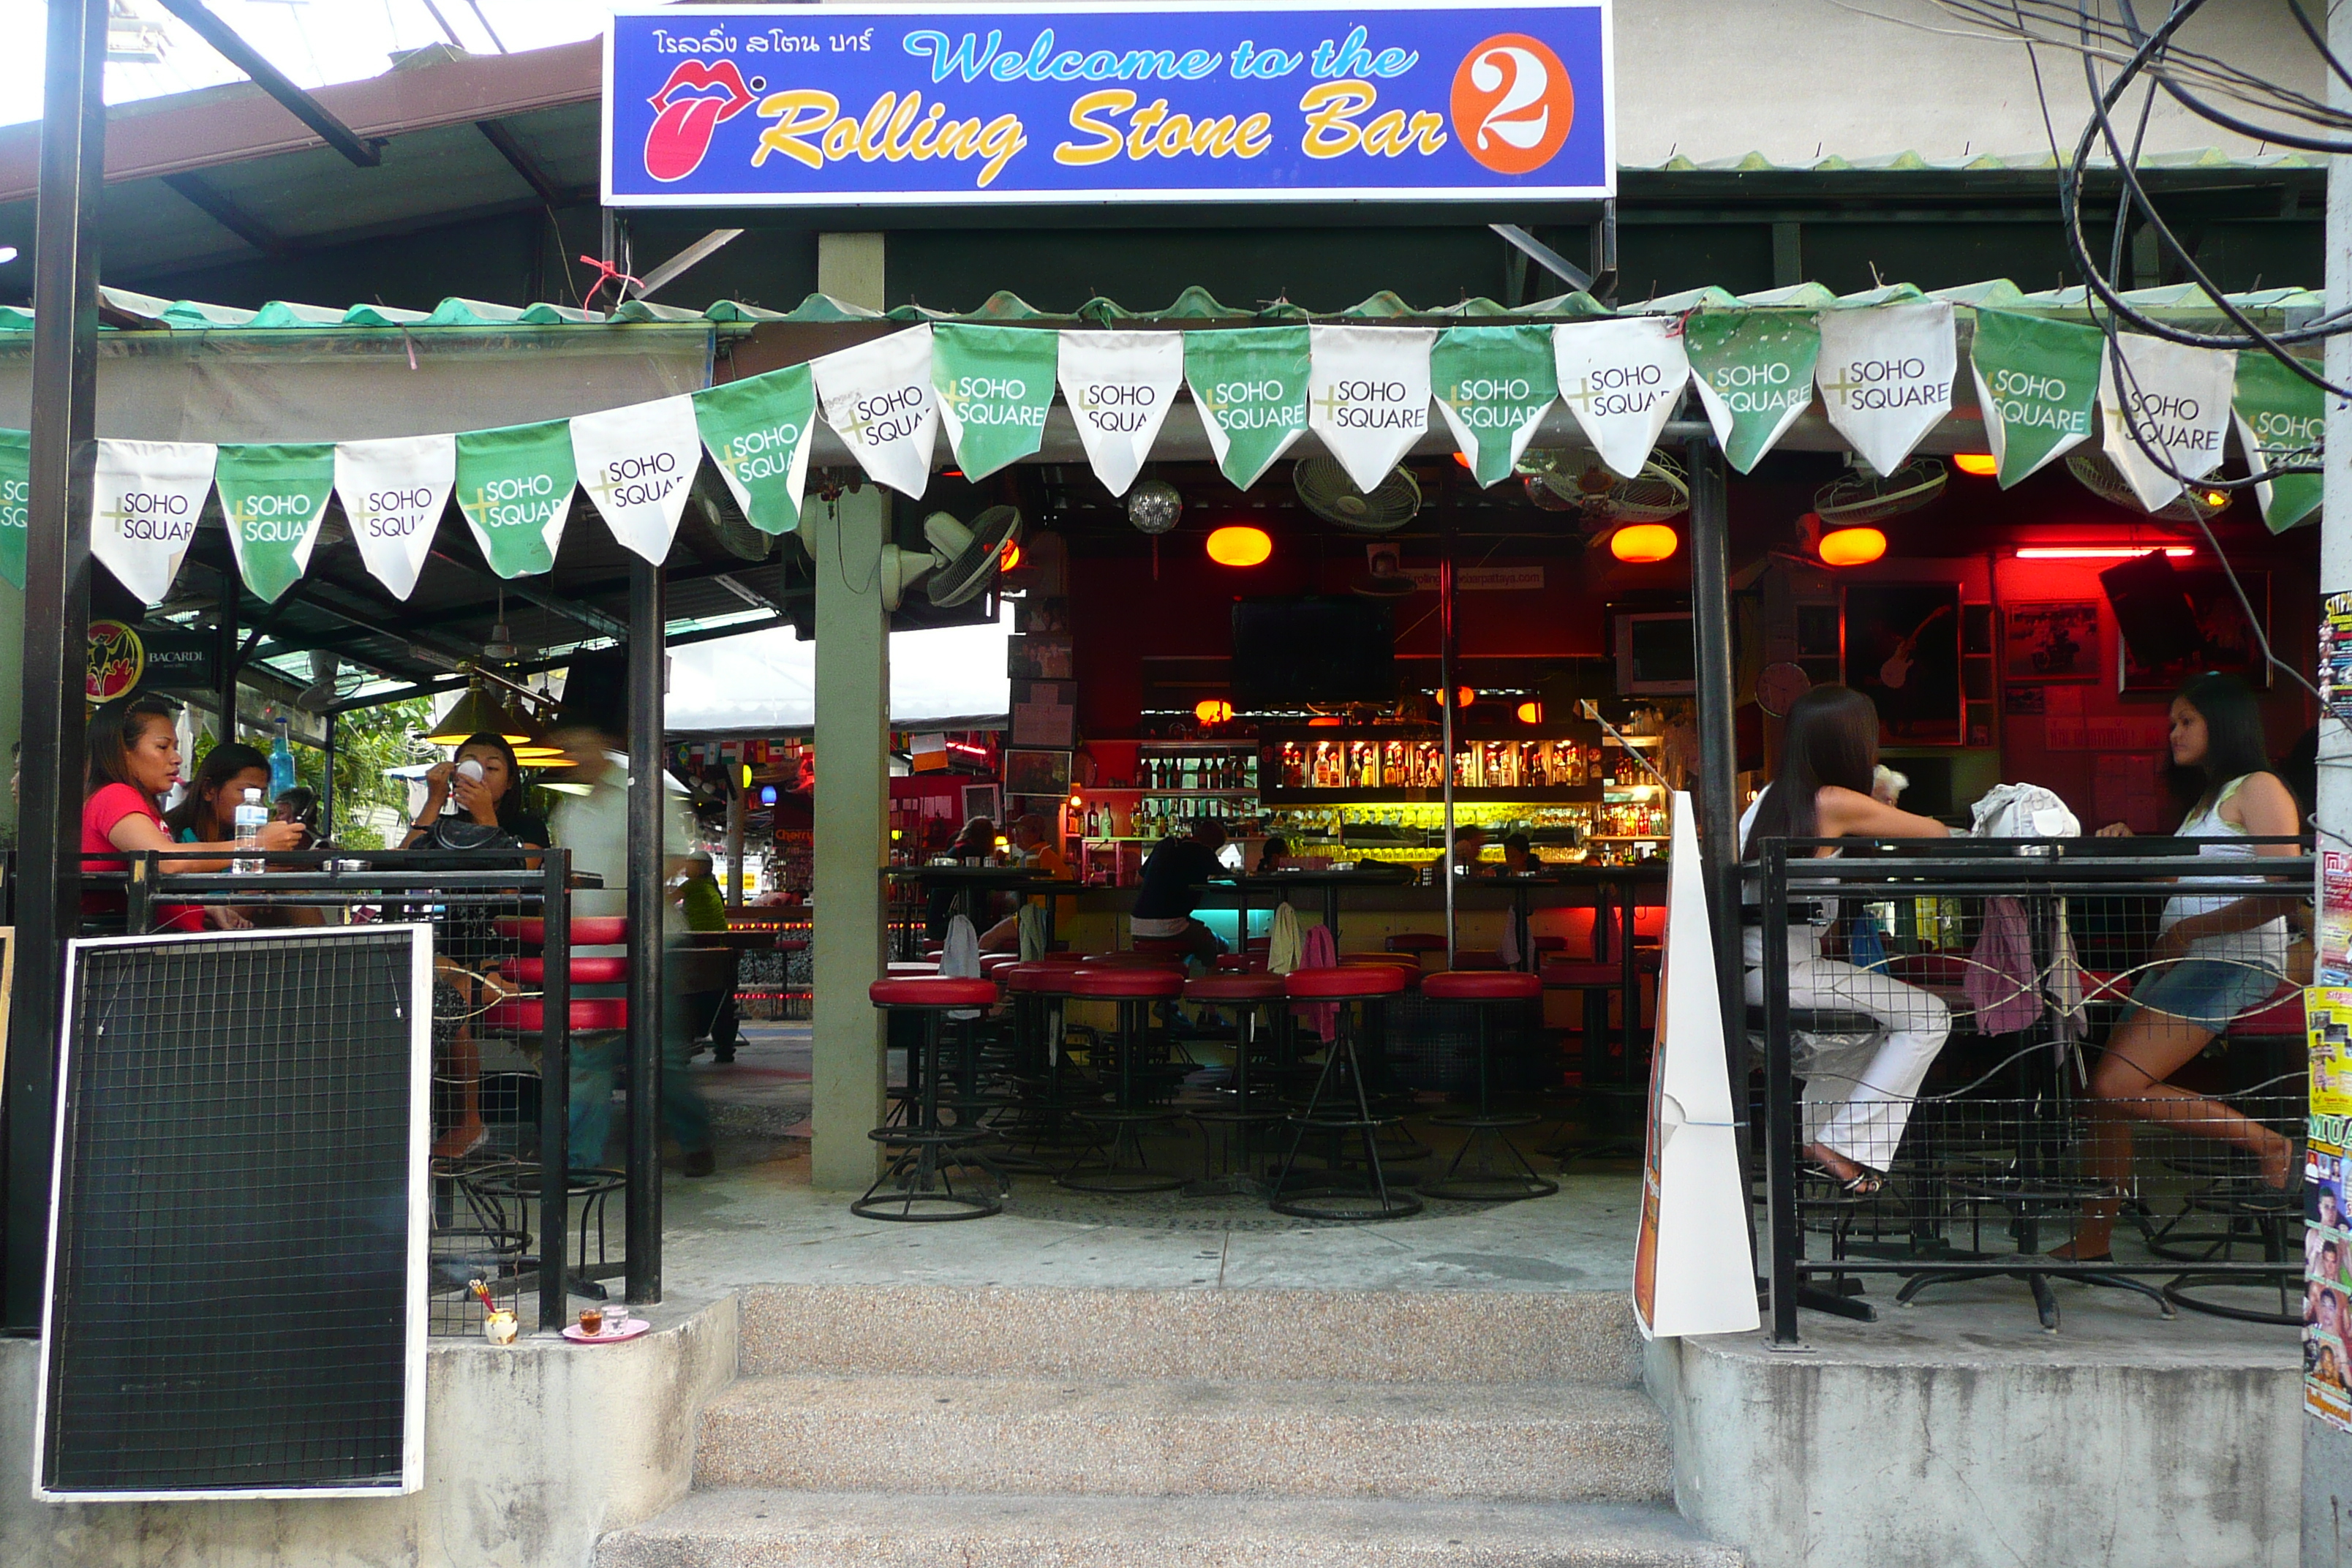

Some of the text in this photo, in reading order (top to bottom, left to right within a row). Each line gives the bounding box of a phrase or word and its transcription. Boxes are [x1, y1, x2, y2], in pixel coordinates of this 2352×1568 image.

[652, 23, 874, 53] โรลลิ่ง สโตน บาร์
[902, 25, 1420, 84] Welcome to the
[1471, 46, 1549, 151] 2
[750, 79, 1448, 189] Rolling Stone Bar
[1591, 364, 1662, 391] SOHO
[1716, 362, 1791, 387] SOHO
[1850, 358, 1926, 382] SOHO
[959, 377, 1026, 400] SOHO
[1088, 385, 1156, 406] SOHO
[1215, 380, 1284, 404] SOHO
[1338, 380, 1406, 402] SOHO
[1460, 378, 1530, 402] SOHO
[1719, 382, 1811, 412] SQUARE
[1852, 382, 1950, 410] SQUARE
[1994, 369, 2066, 402] SOHO
[858, 386, 923, 421] SOHO
[957, 403, 1045, 427] SQUARE
[1594, 391, 1670, 417] SQUA
[1992, 397, 2086, 431] SQUARE
[2130, 391, 2199, 421] SOHO
[866, 407, 931, 446] SQUA
[1217, 404, 1305, 430] SQUARE
[1336, 407, 1426, 429] SQUARE
[2257, 411, 2325, 440] SOHO
[733, 423, 799, 457] SOHO
[609, 452, 675, 482] SOHO
[369, 488, 432, 512] SOHO
[486, 474, 553, 502] SOHO
[614, 476, 684, 508] SQUA
[124, 493, 188, 515] SOHO
[246, 494, 310, 516] SOHO
[245, 520, 313, 541] SQUA
[369, 514, 424, 537] SQU
[148, 651, 203, 663] BACARDI
